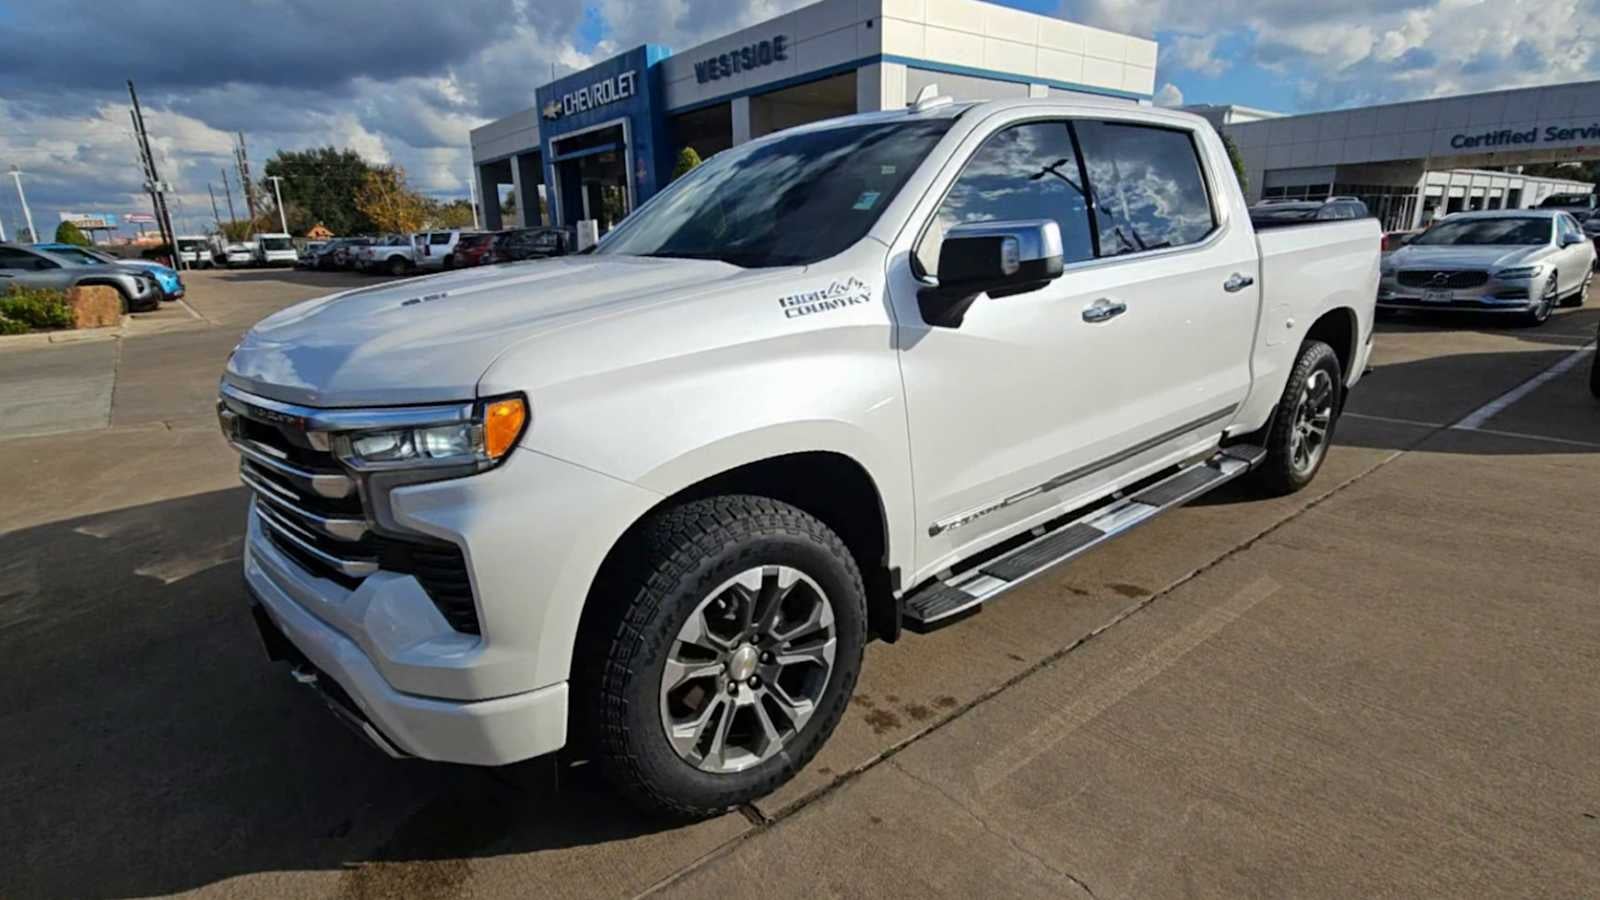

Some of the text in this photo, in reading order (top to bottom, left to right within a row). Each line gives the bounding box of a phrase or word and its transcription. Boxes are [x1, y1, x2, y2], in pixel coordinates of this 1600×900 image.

[695, 35, 787, 84] WESTSIDE
[563, 69, 636, 115] CHEVROLET
[1450, 123, 1600, 149] Certified Servi
[779, 290, 828, 308] HIGH
[785, 292, 871, 319] COUNTRY
